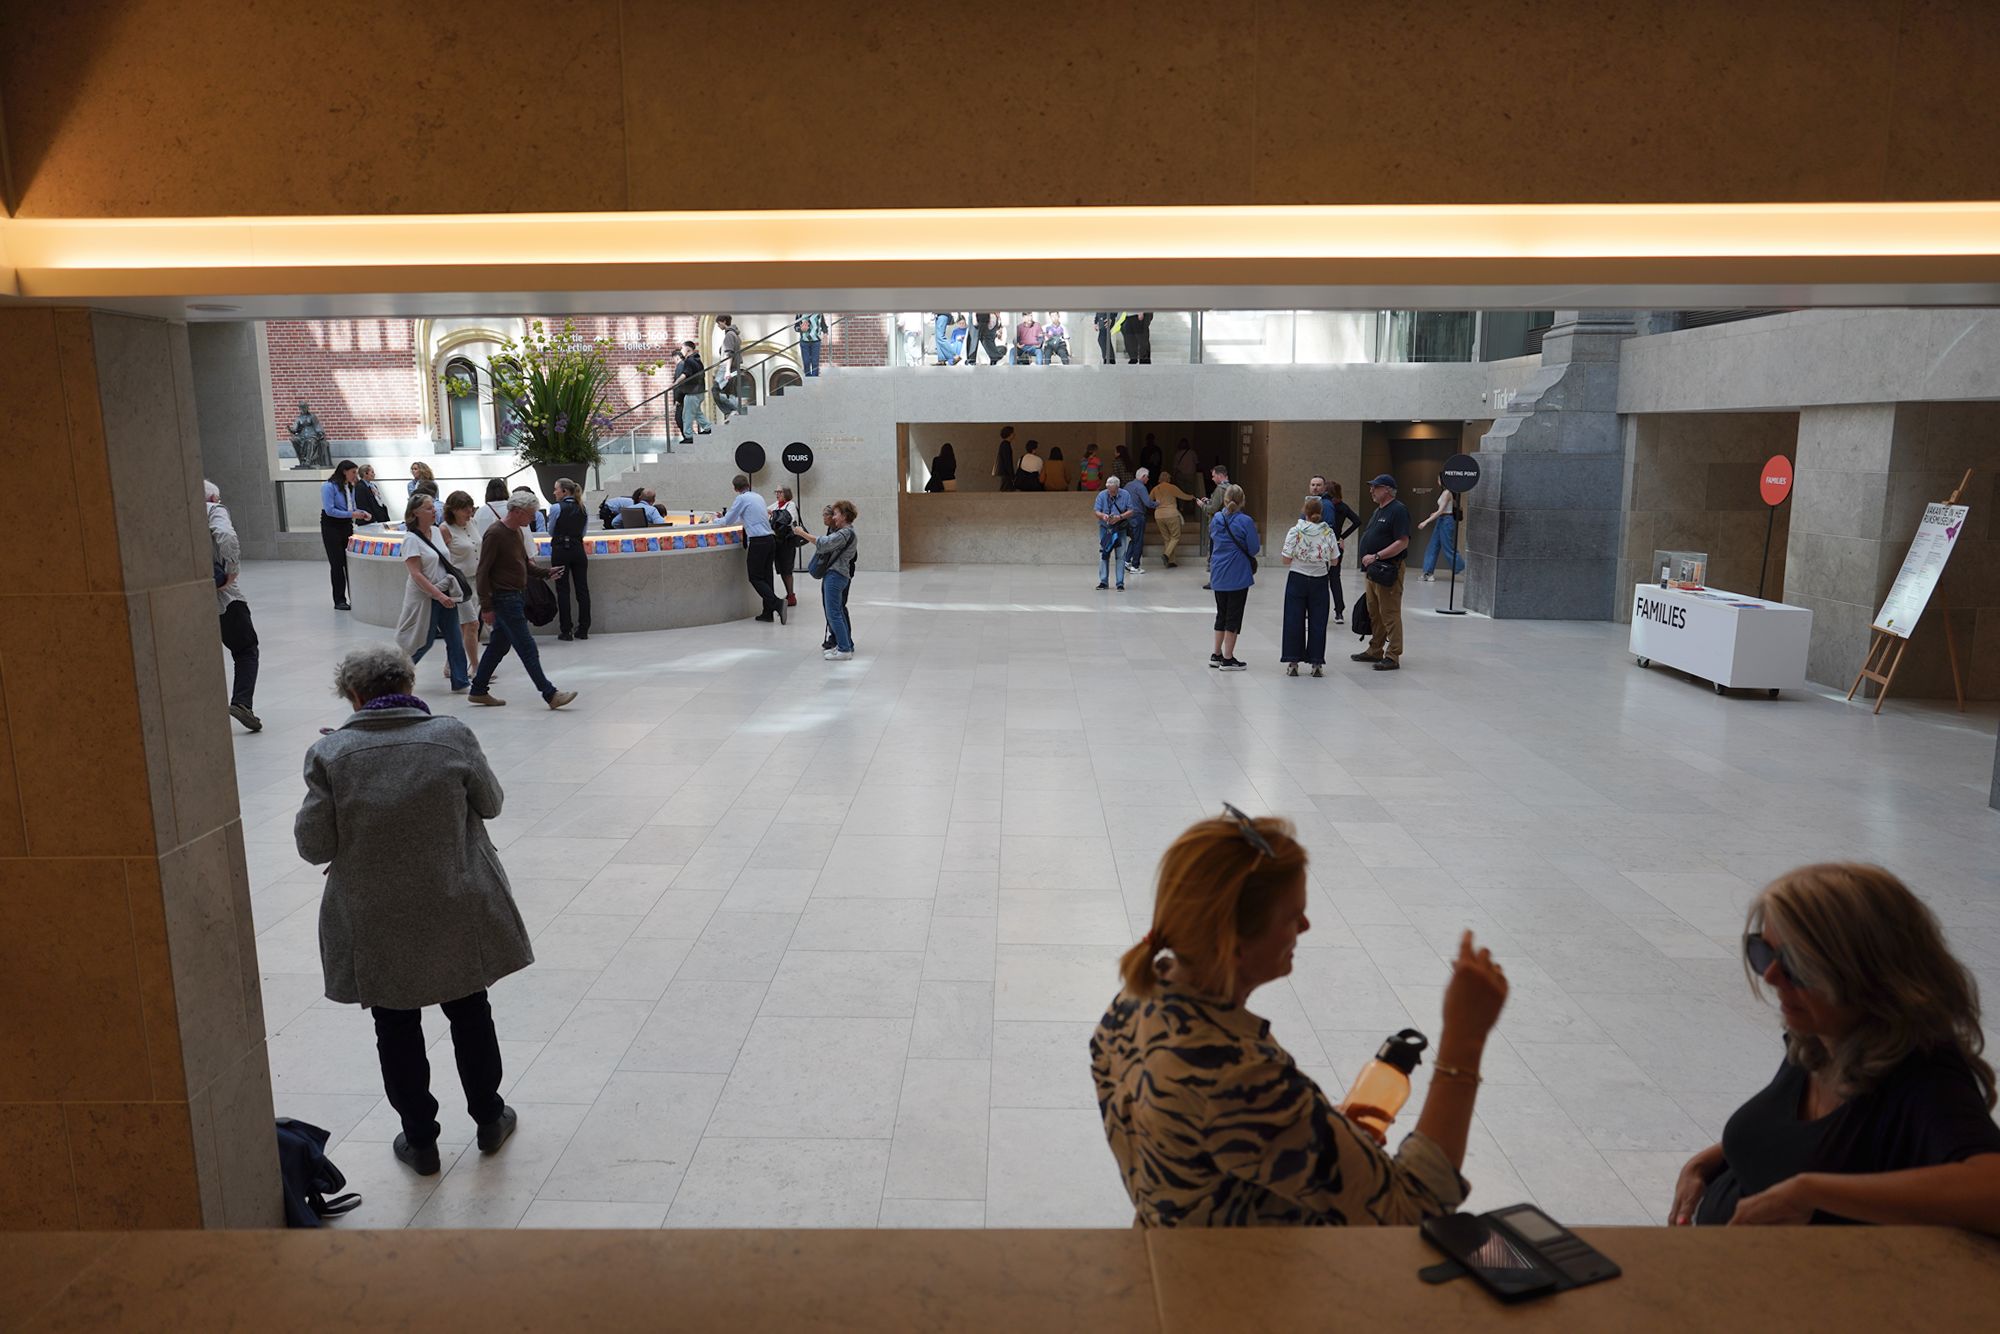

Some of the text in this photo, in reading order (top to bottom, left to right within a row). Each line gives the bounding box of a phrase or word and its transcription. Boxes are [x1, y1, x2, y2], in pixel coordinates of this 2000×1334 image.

[623, 341, 650, 350] Toilets
[1766, 476, 1786, 485] FAMILIES
[1636, 597, 1687, 629] FAMILIES
